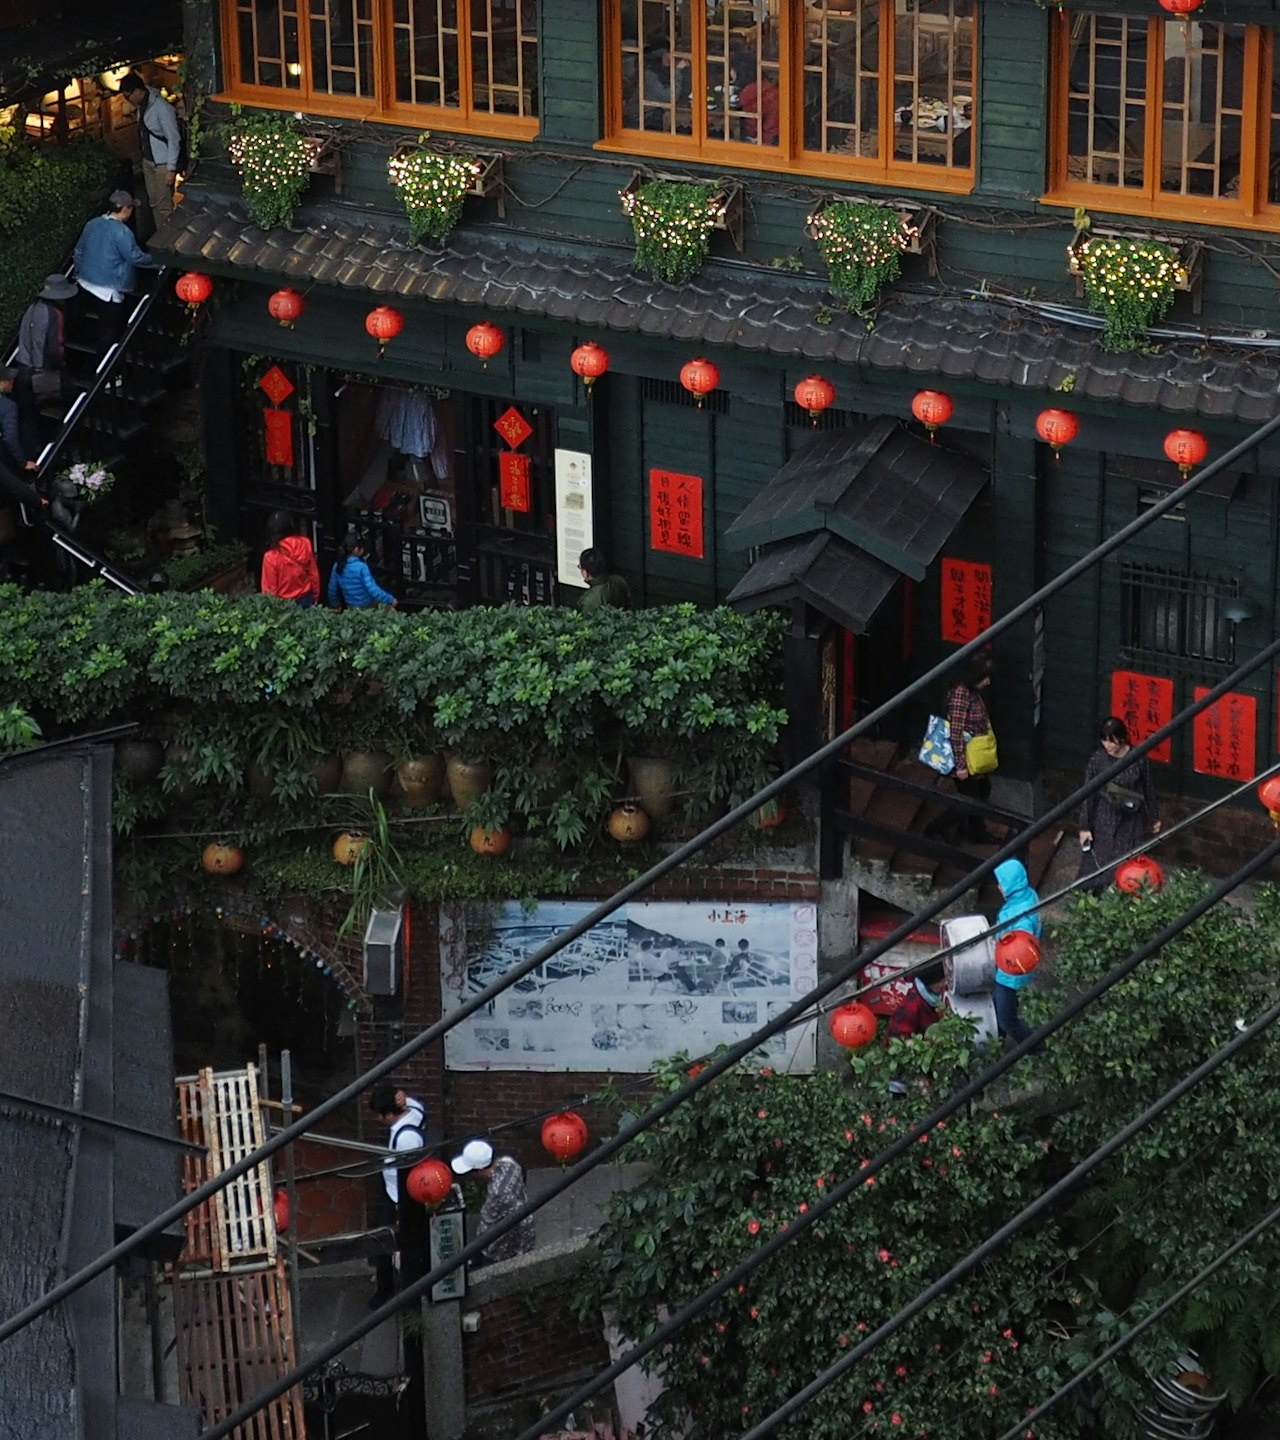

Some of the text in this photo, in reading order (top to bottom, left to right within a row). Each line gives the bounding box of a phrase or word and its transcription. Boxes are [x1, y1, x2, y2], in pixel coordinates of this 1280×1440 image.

[656, 476, 674, 547] 日後好相見
[677, 481, 694, 548] 人情留一線
[707, 909, 750, 926] 小上海
